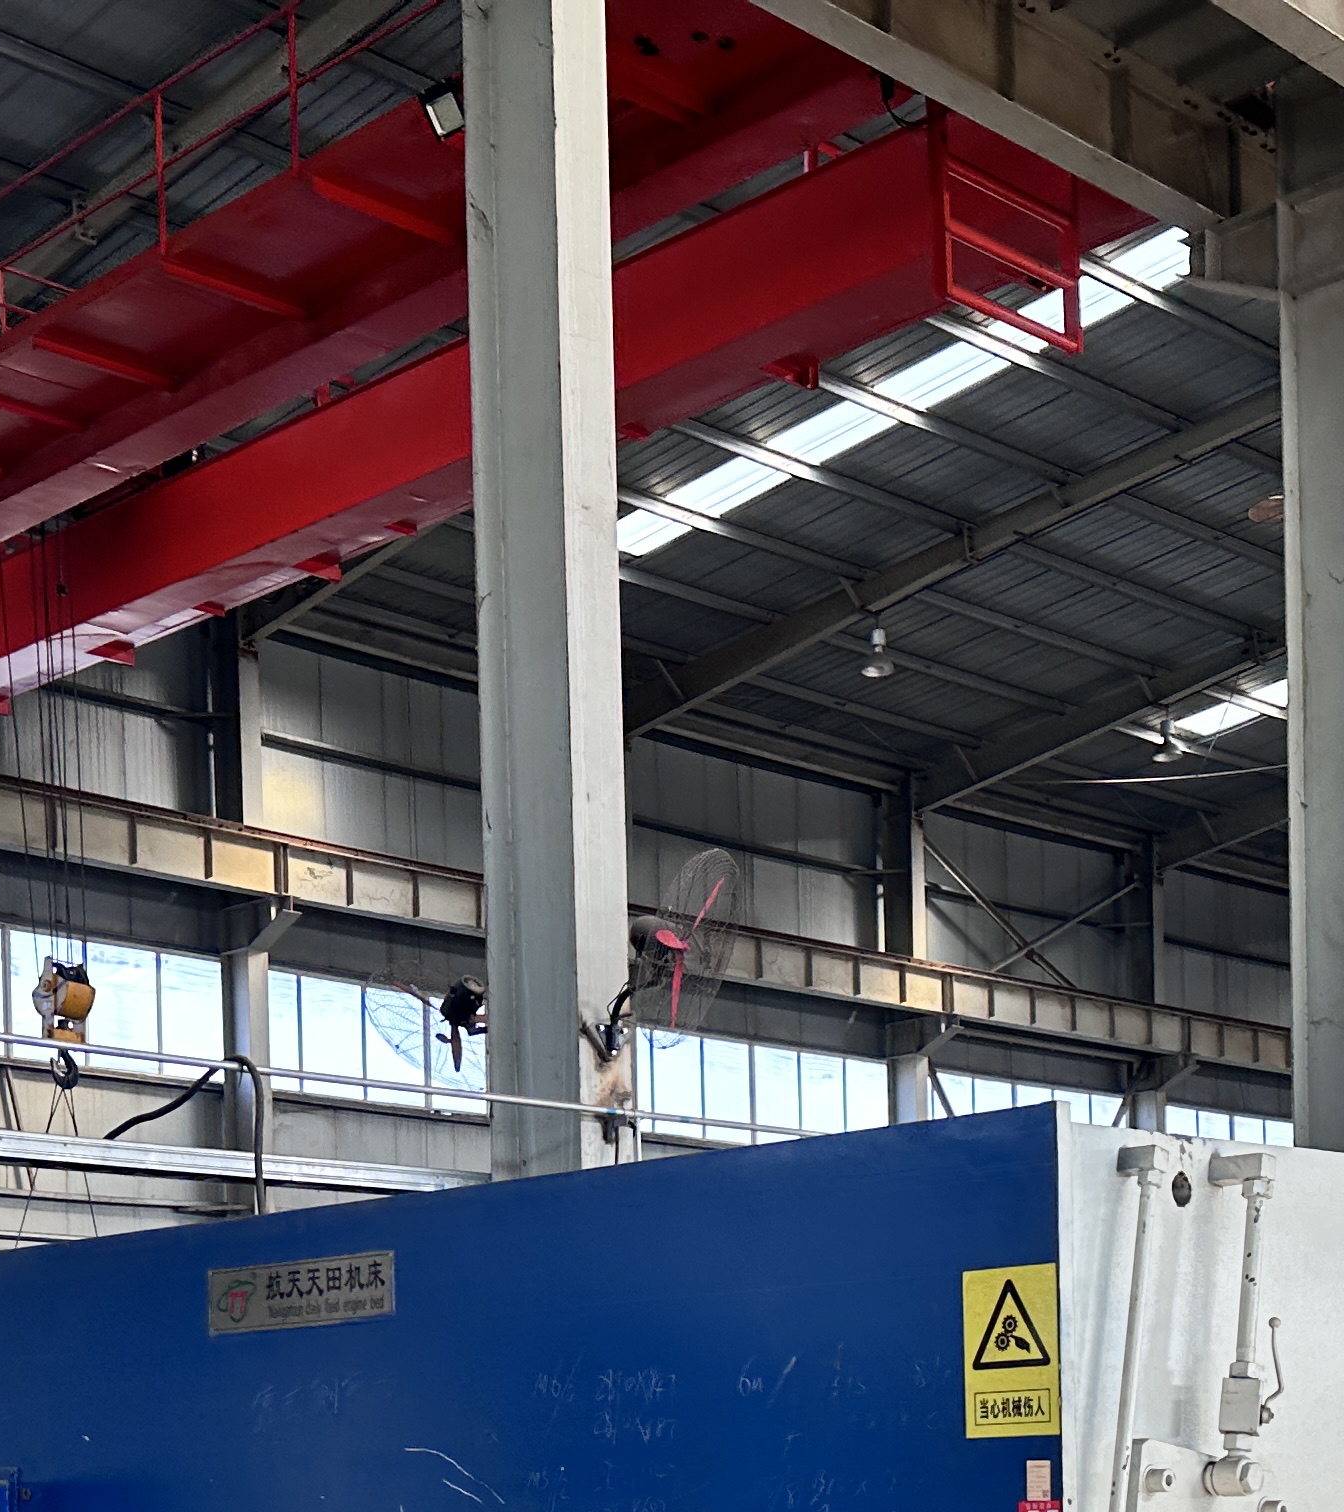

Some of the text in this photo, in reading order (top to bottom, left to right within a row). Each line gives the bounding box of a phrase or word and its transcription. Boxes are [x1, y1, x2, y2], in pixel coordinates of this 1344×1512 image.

[265, 1259, 386, 1301] 航天天田机床
[979, 1395, 1046, 1420] 当心机械伤人
